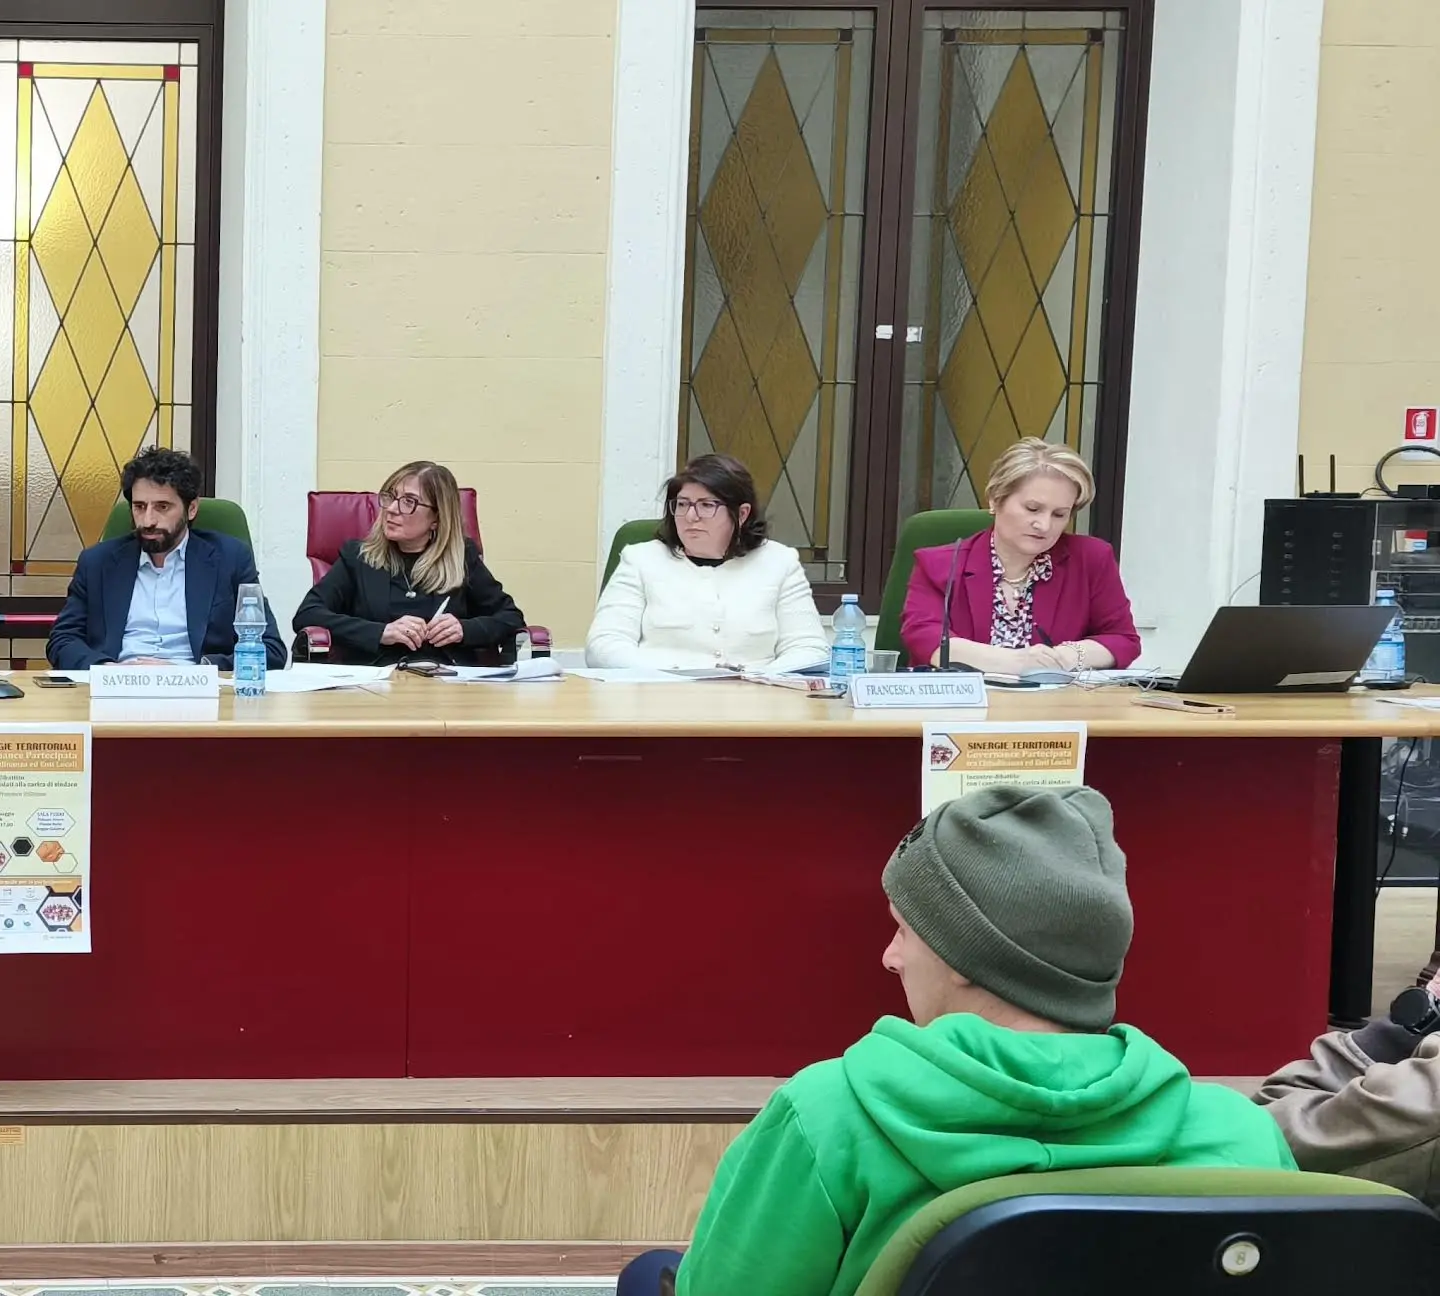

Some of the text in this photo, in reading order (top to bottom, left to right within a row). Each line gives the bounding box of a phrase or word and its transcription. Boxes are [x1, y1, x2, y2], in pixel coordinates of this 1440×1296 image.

[102, 674, 209, 686] SAVERIO PAZZANO
[866, 684, 974, 695] FRANCESCA STILLITTANO
[1012, 741, 1072, 749] TERRITORIALI
[25, 751, 78, 761] Partecipata
[1022, 750, 1072, 759] Partecipata
